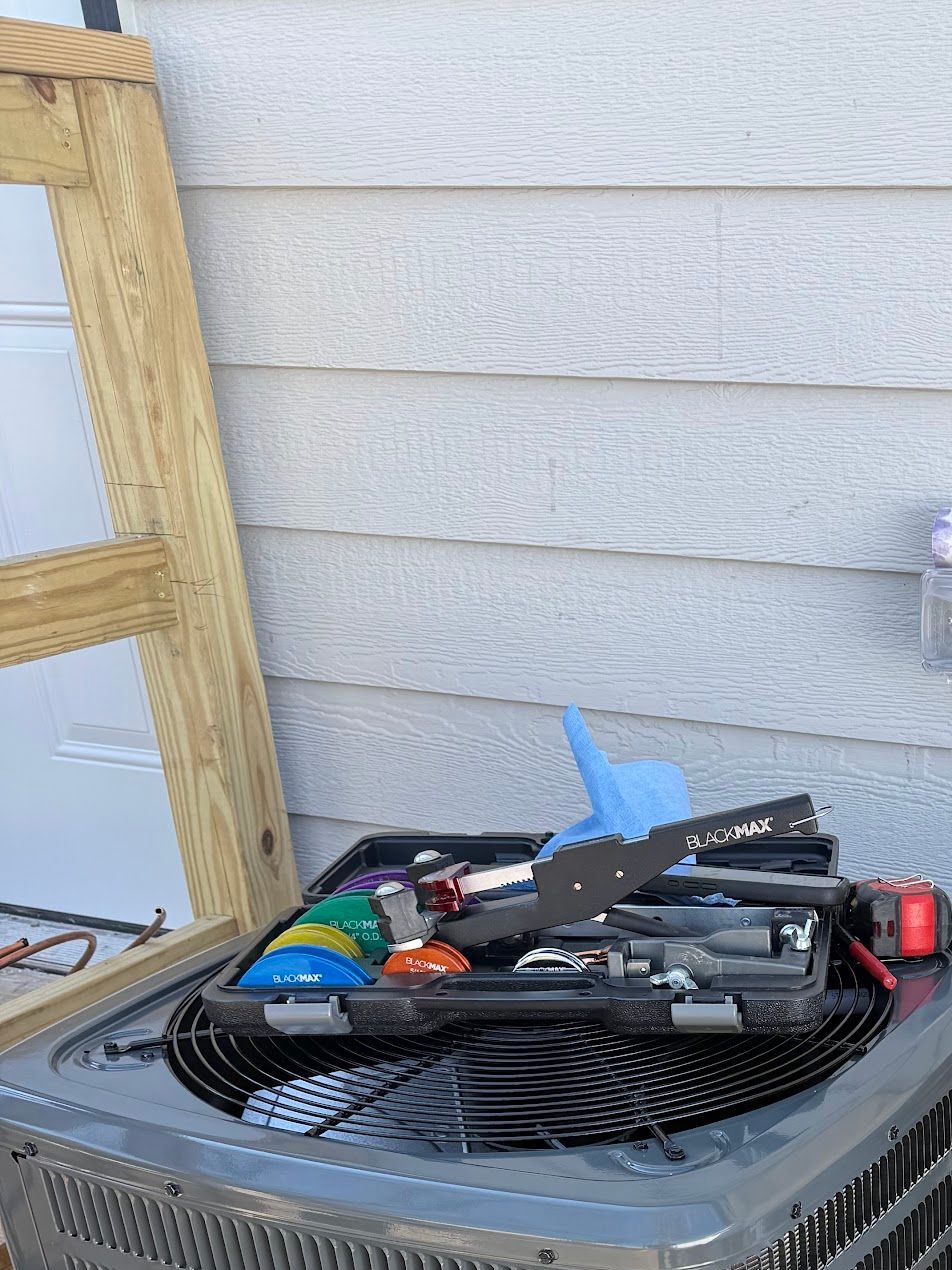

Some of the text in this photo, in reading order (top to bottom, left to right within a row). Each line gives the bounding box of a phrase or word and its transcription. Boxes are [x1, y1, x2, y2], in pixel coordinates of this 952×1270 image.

[685, 816, 774, 850] BLACKMAX
[329, 920, 379, 930] BLACKMA
[405, 956, 449, 973] BLACKMAX
[272, 973, 322, 984] BLACKMAX
